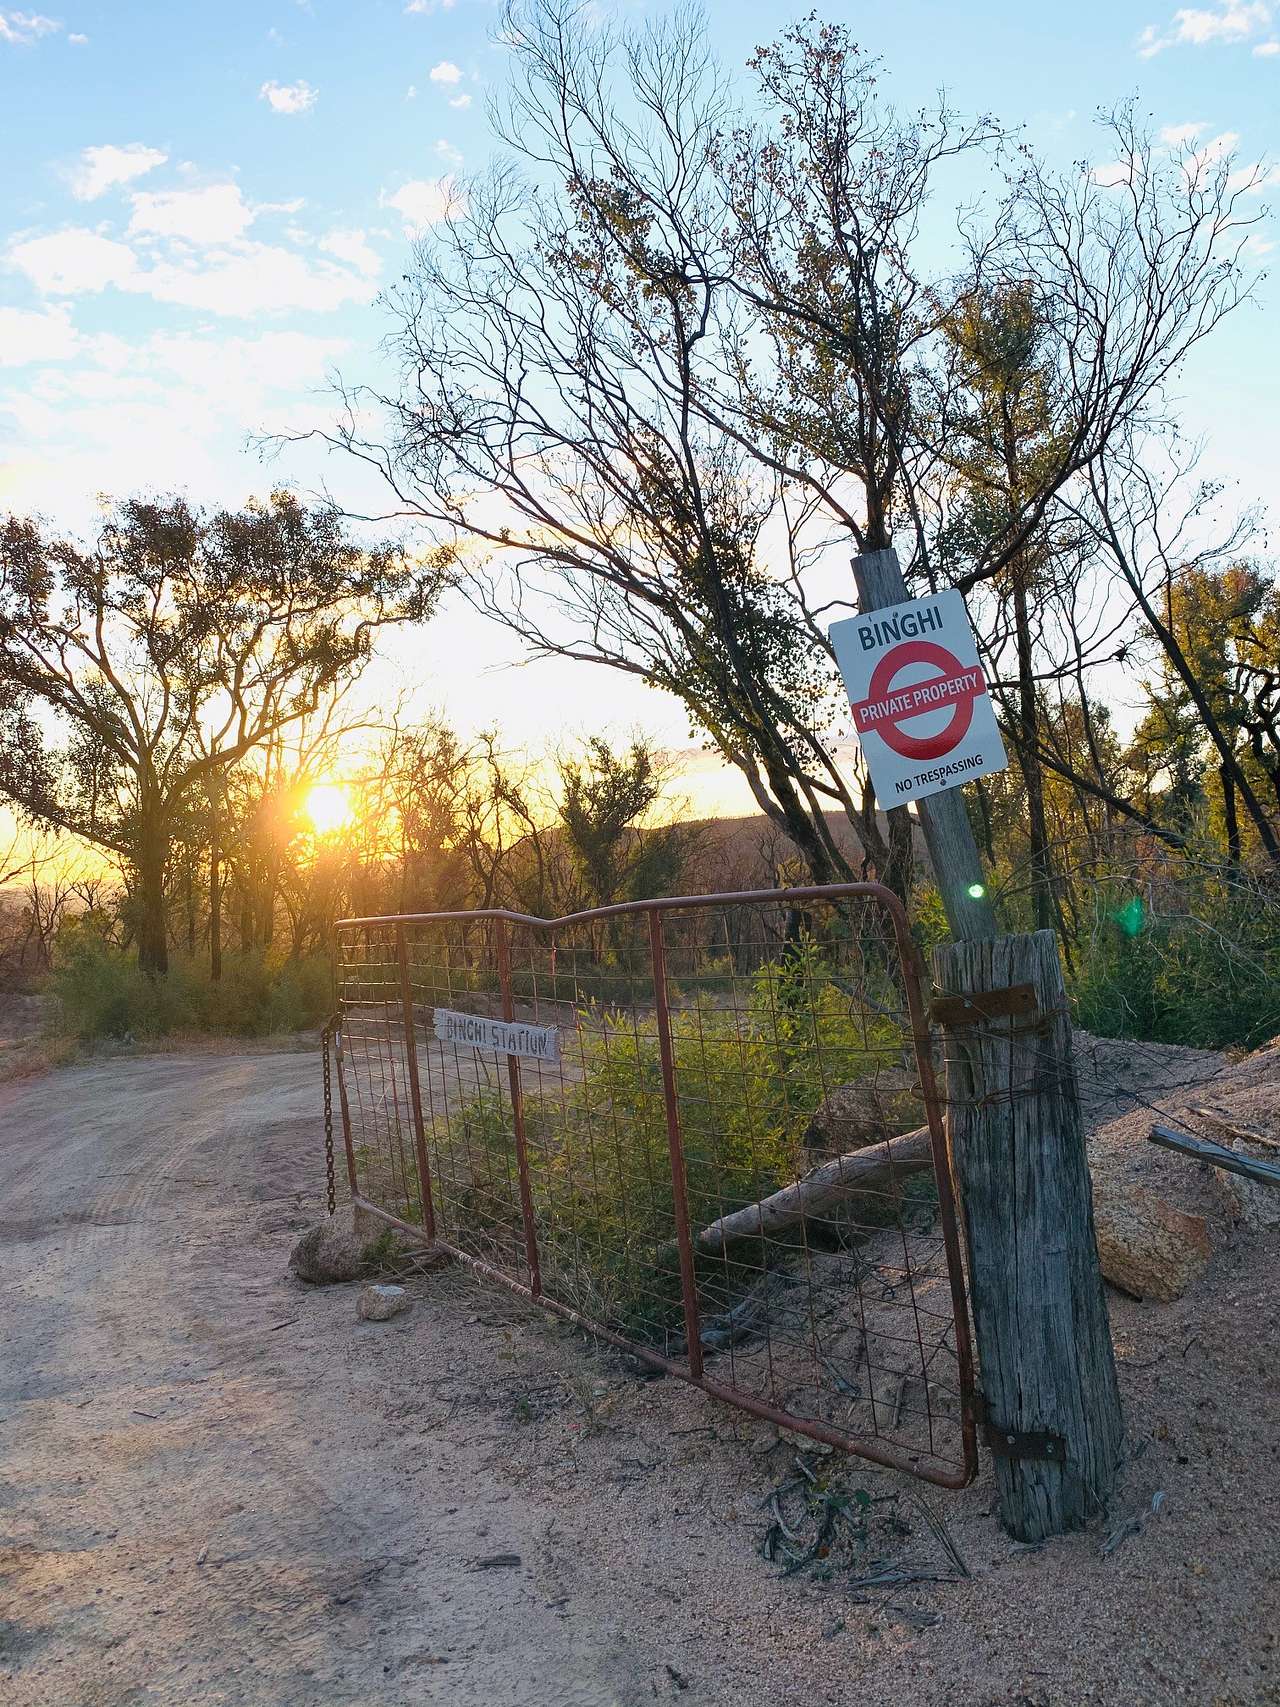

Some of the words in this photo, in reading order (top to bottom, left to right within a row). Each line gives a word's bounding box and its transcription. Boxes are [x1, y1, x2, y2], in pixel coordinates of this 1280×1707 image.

[857, 606, 943, 651] BINGHI
[859, 693, 913, 723] PRIVATE
[913, 673, 977, 707] PROPERTY
[895, 779, 912, 793] NO
[914, 754, 984, 785] TRESPASSING
[491, 1026, 547, 1055] STATION
